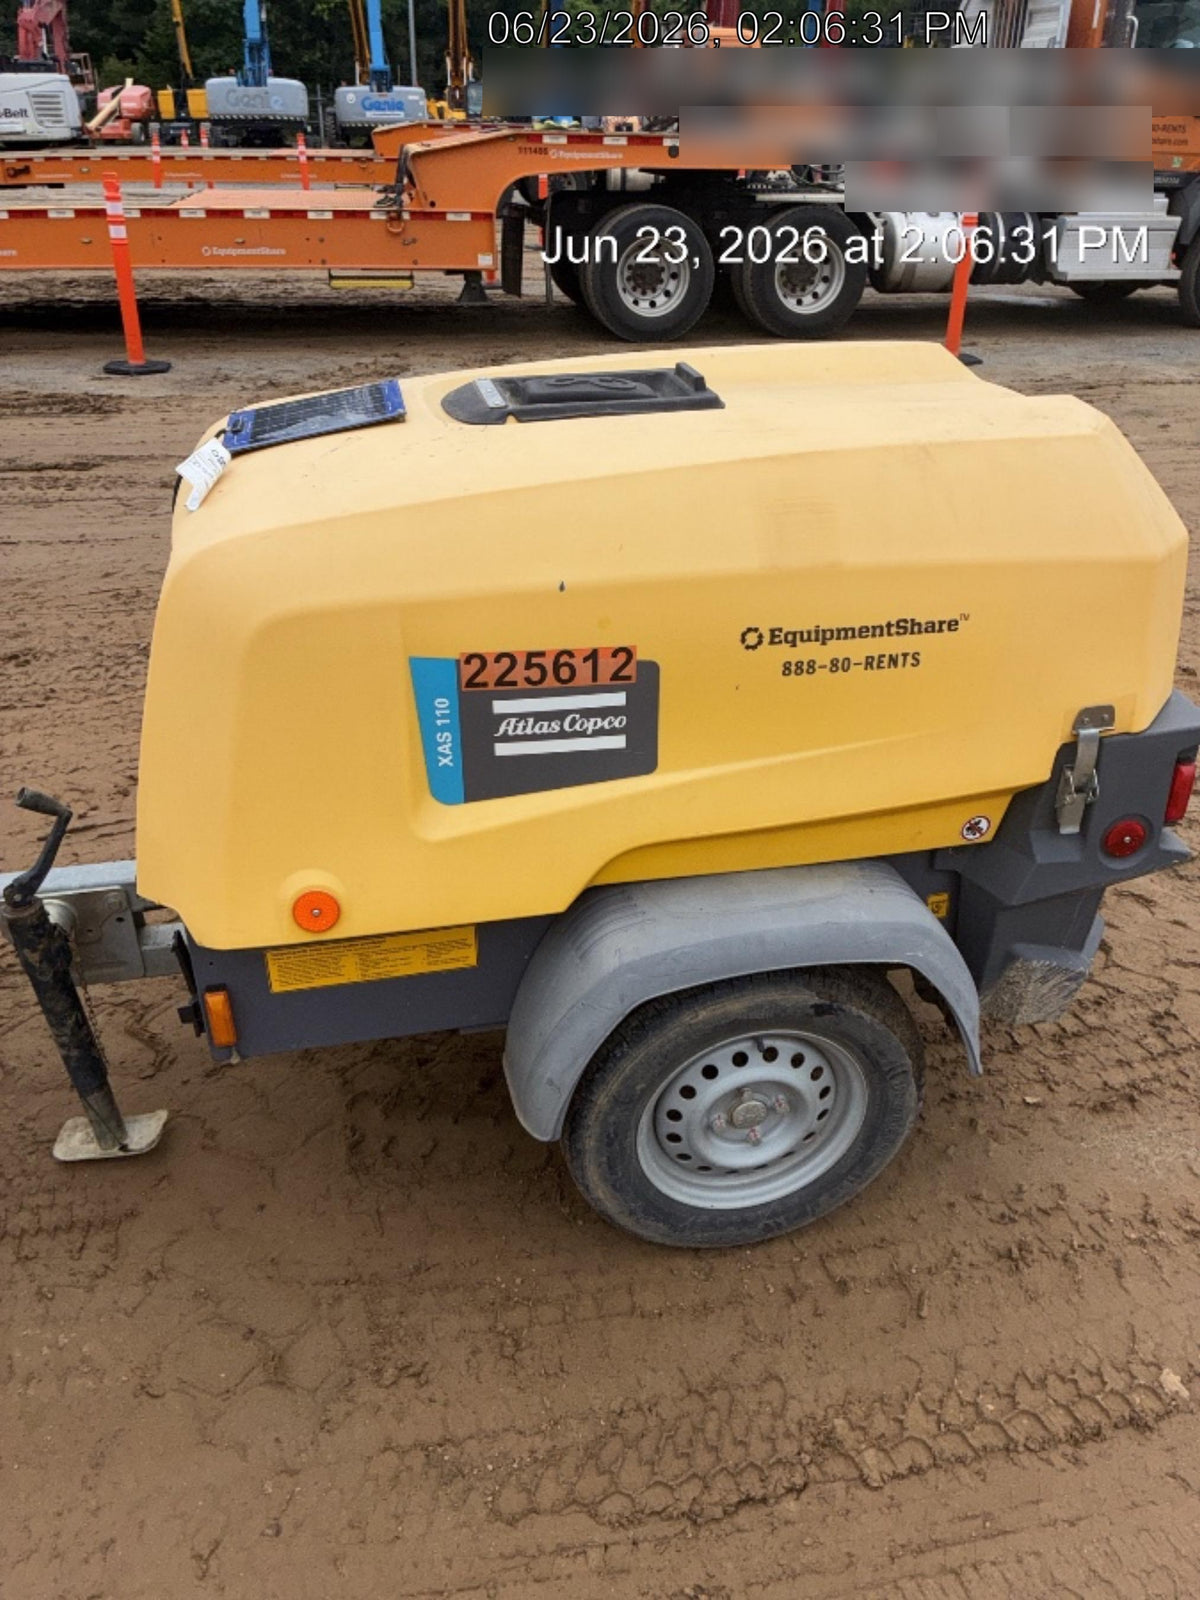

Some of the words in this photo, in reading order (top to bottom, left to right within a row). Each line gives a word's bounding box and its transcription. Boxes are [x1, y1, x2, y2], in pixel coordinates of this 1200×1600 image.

[0, 107, 29, 118] -Belt
[360, 96, 405, 112] Genie
[768, 618, 960, 648] EquipmentShare
[462, 646, 635, 689] 225612
[782, 652, 921, 677] 888-80-RENTS
[434, 698, 450, 725] 110
[494, 717, 561, 737] Atlas
[563, 714, 627, 736] Copco
[437, 731, 454, 767] XAS
